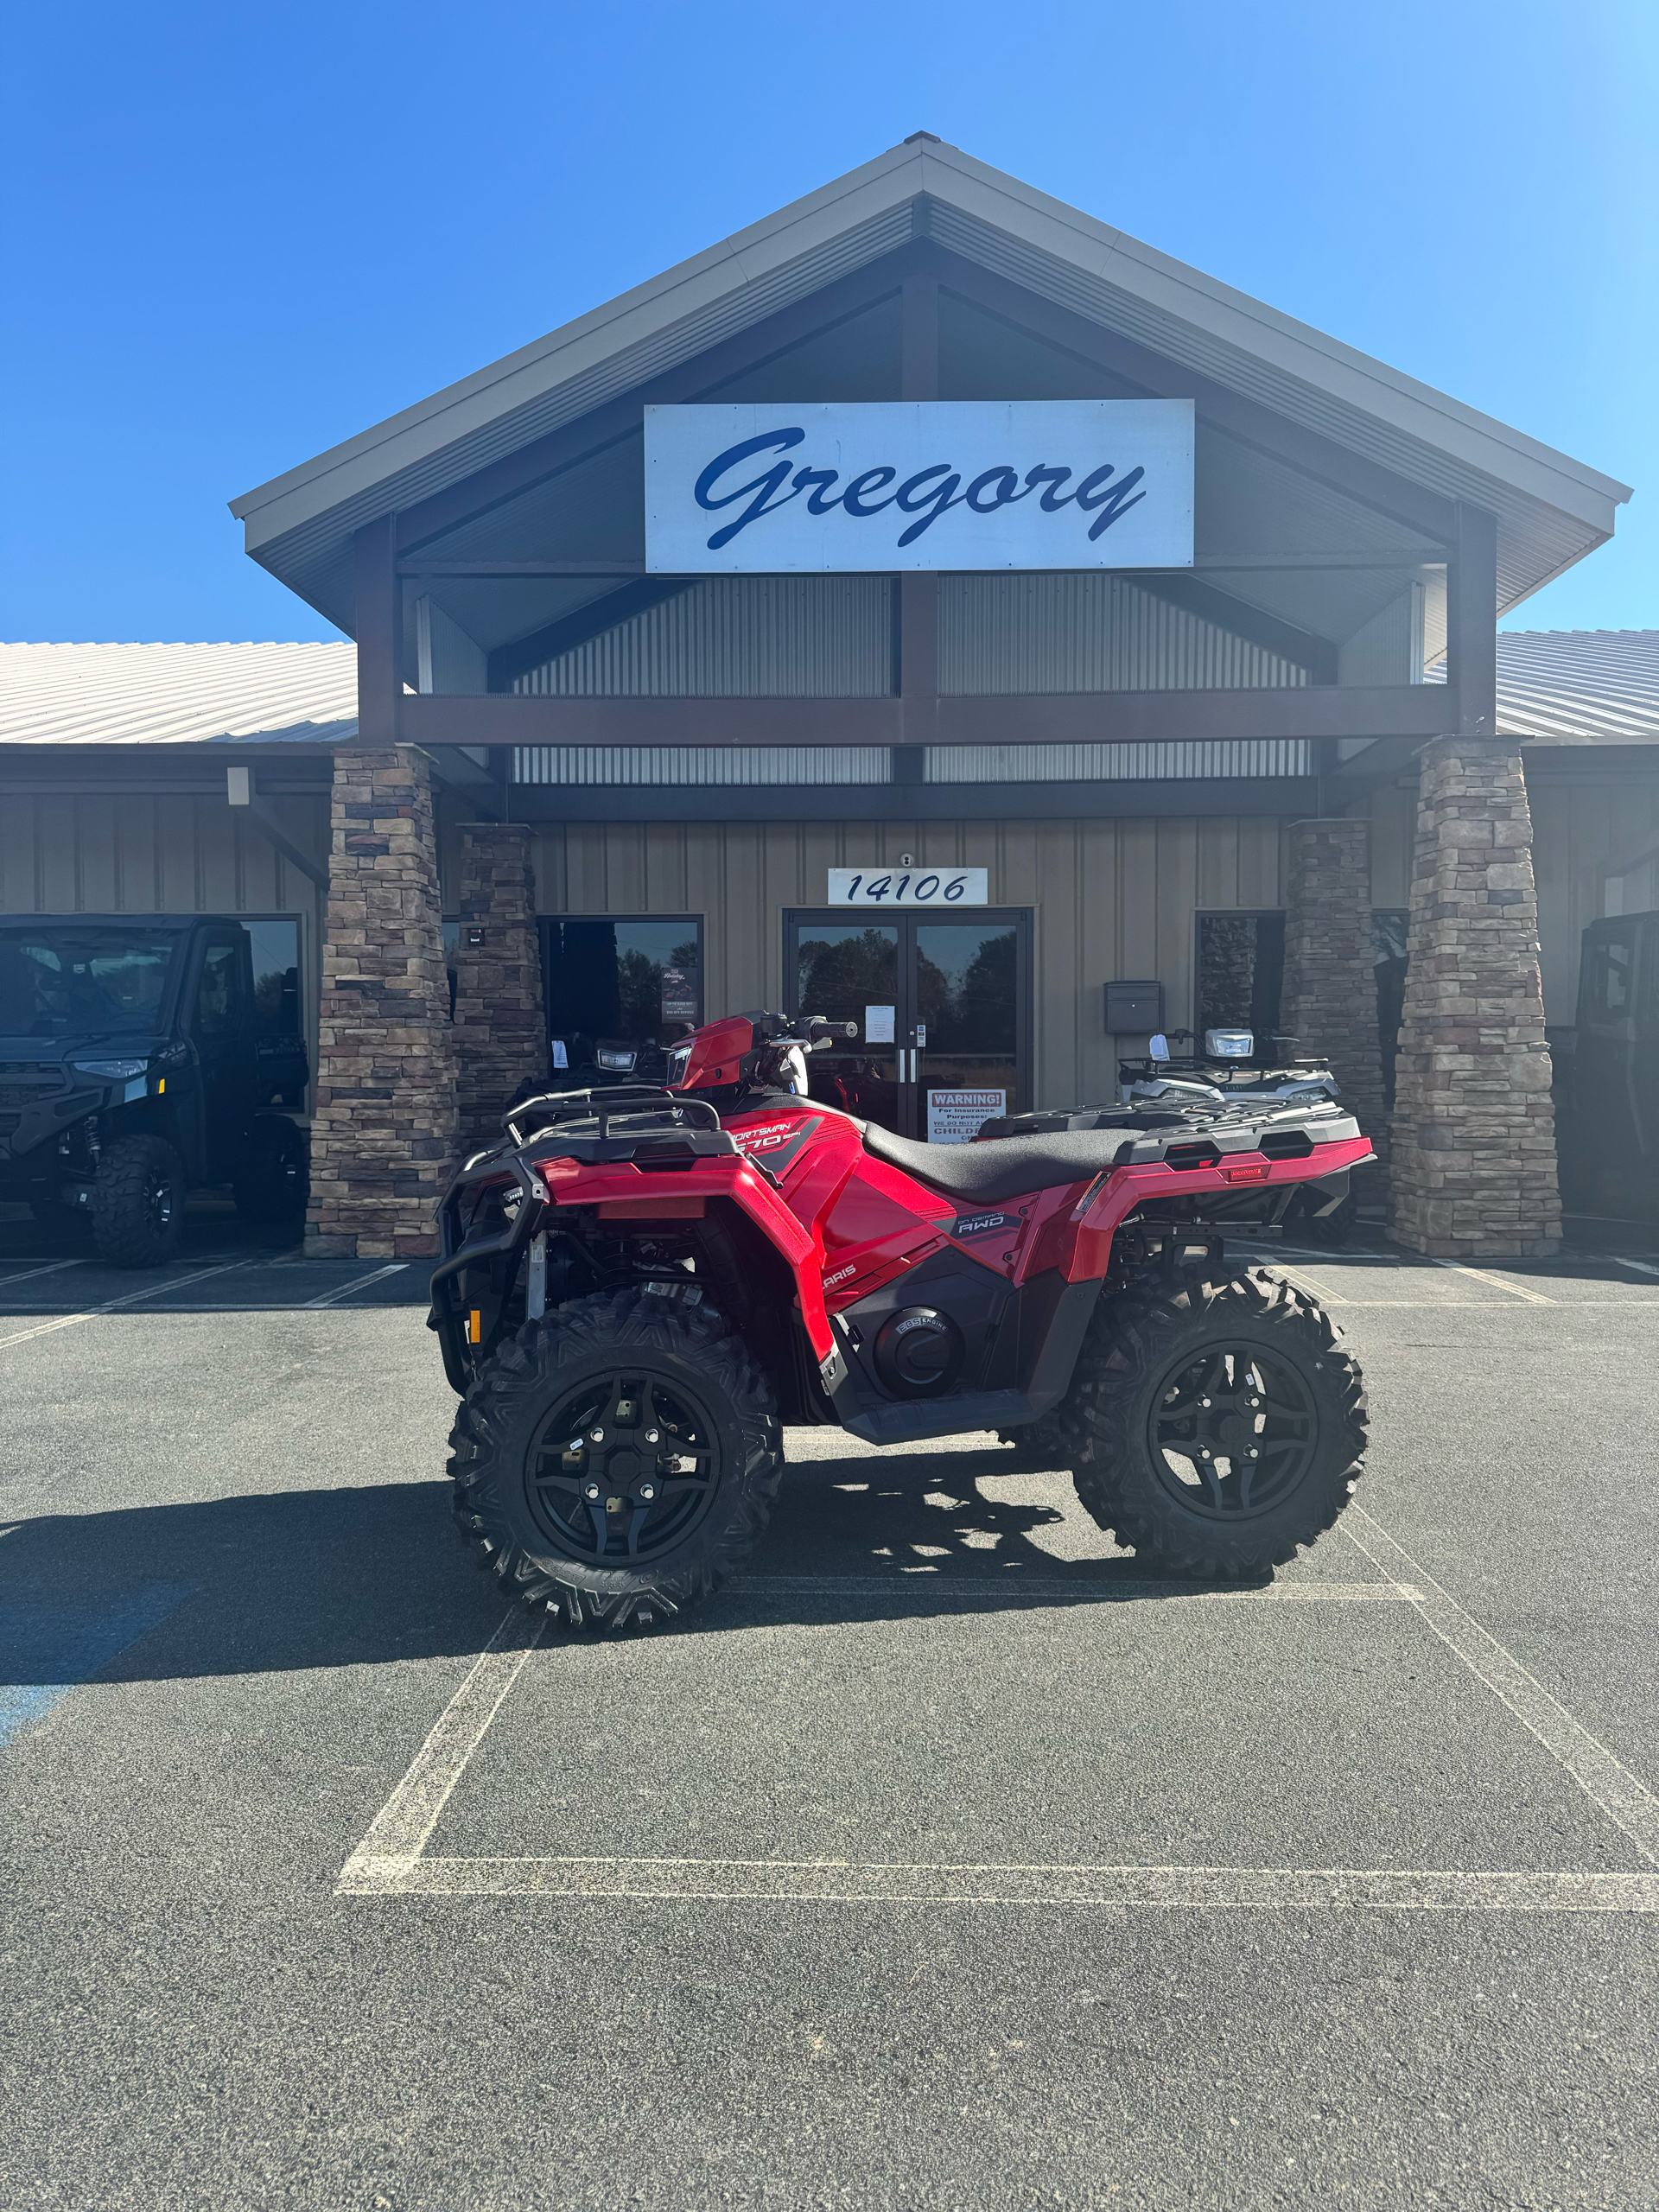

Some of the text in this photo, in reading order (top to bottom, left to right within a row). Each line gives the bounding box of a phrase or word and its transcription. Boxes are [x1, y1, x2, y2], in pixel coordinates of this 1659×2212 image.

[694, 427, 1147, 550] Gregory
[848, 874, 968, 901] 14106
[935, 1094, 1000, 1104] WARNING!
[732, 1122, 791, 1141] ORTSMAN
[958, 1216, 1004, 1234] AWD
[823, 1264, 856, 1289] ARIS
[899, 1318, 947, 1332] EBS ENGINE
